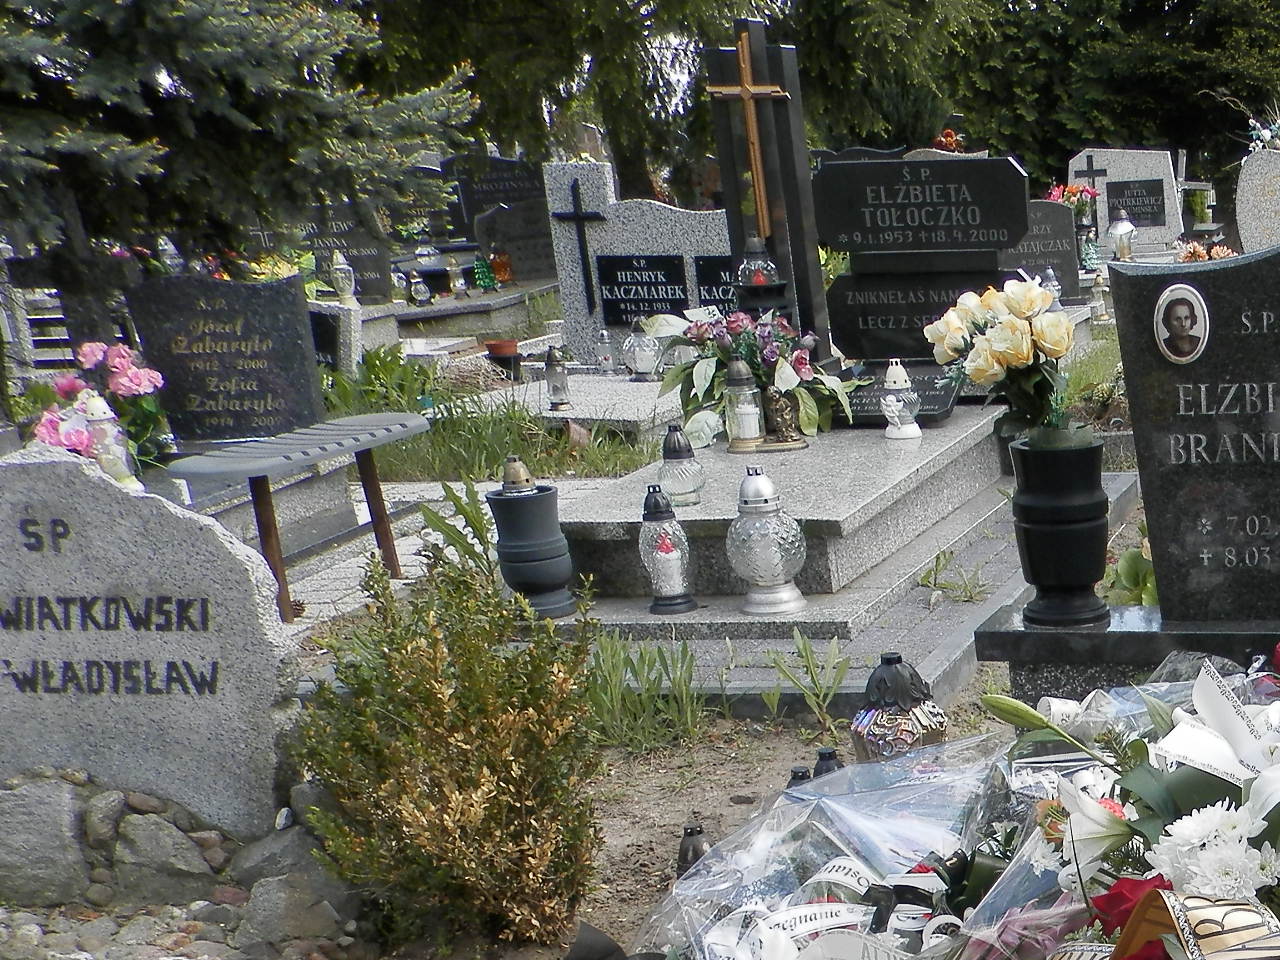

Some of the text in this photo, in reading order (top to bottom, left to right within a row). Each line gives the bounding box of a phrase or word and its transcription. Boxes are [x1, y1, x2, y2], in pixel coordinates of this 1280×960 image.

[866, 182, 972, 204] ELŻBIETA
[861, 205, 981, 228] TOŁOCZKO
[616, 271, 667, 283] HENRYK
[601, 285, 686, 299] KACZMAREK
